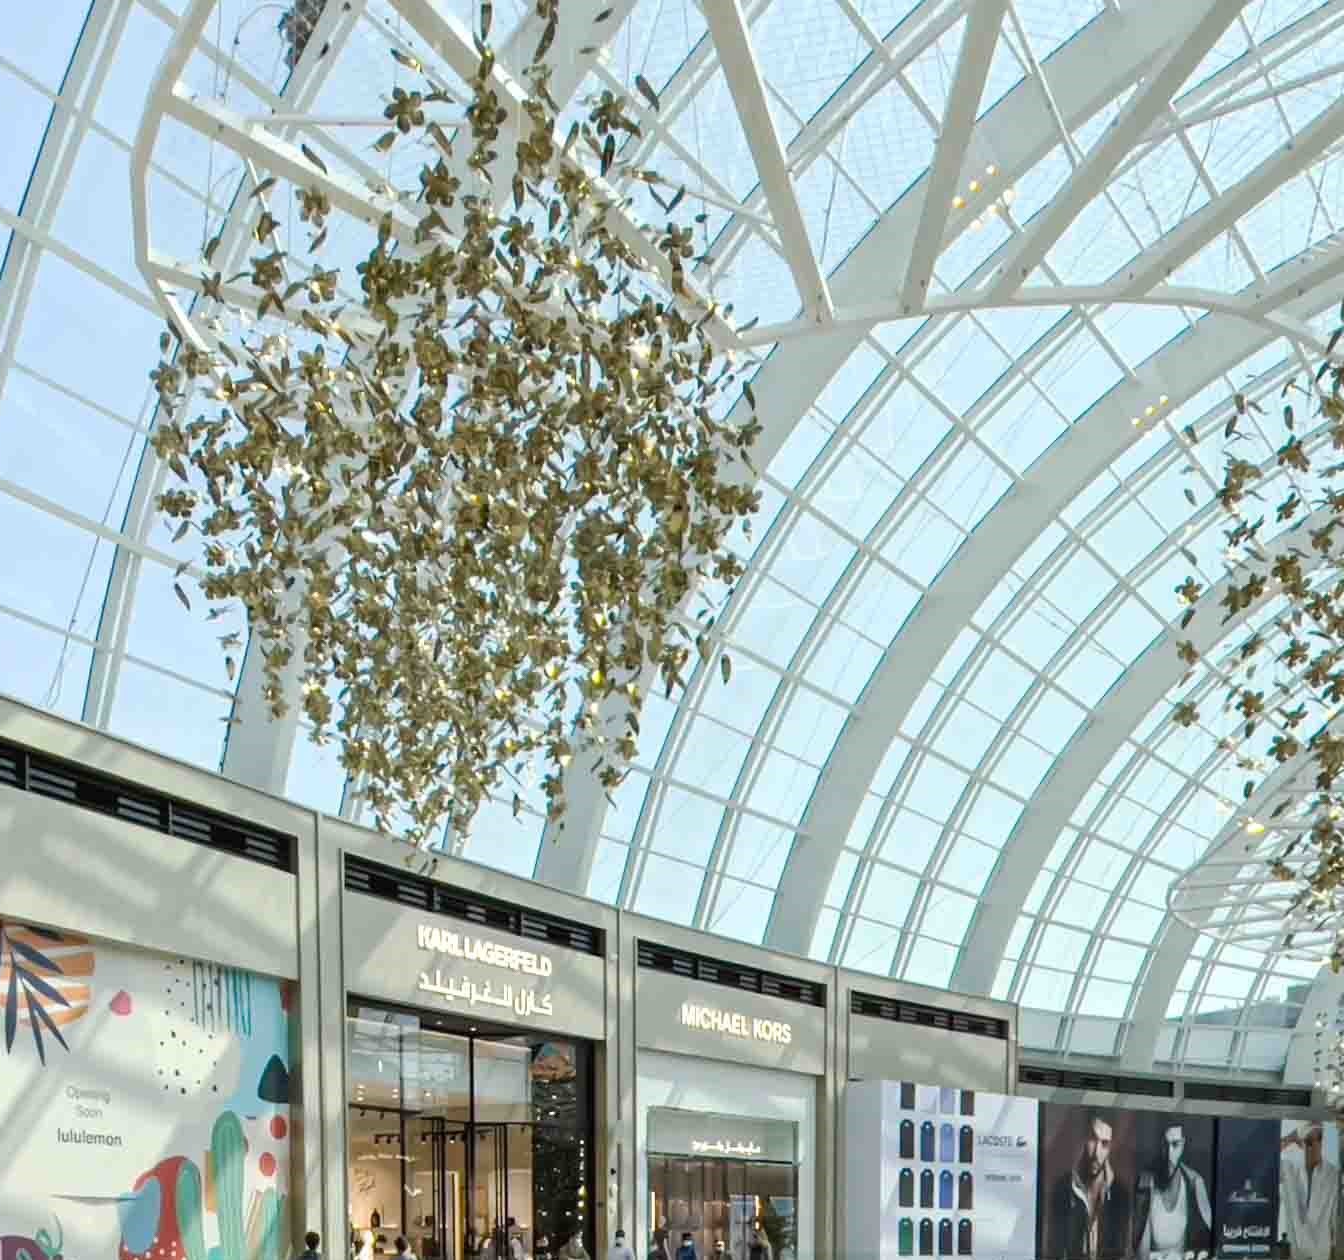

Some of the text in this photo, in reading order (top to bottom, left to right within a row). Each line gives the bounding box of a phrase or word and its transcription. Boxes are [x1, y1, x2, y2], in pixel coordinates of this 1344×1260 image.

[417, 923, 553, 977] KARL LAGERFELD
[681, 1002, 792, 1044] MICHAEL KORS
[57, 1127, 123, 1147] lululemon
